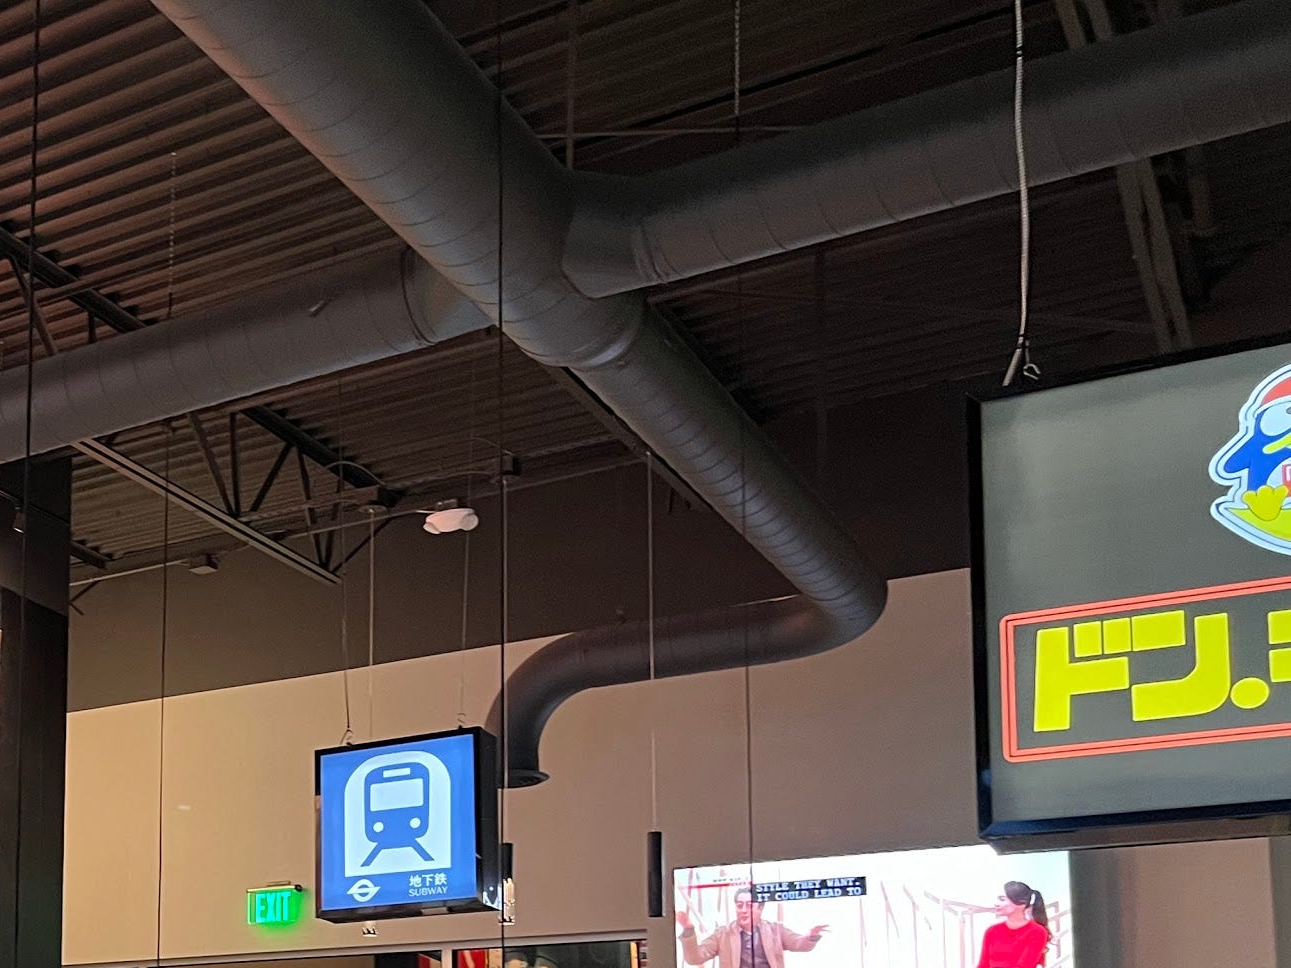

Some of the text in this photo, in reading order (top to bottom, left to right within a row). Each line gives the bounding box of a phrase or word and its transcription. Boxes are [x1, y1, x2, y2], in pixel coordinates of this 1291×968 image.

[409, 872, 448, 888] 地下鉄
[755, 882, 790, 892] STYLE
[794, 879, 822, 889] THEY
[408, 886, 449, 897] SUBWAY
[757, 886, 862, 903] IT COULD LEAD TO
[255, 891, 292, 924] EXIT
